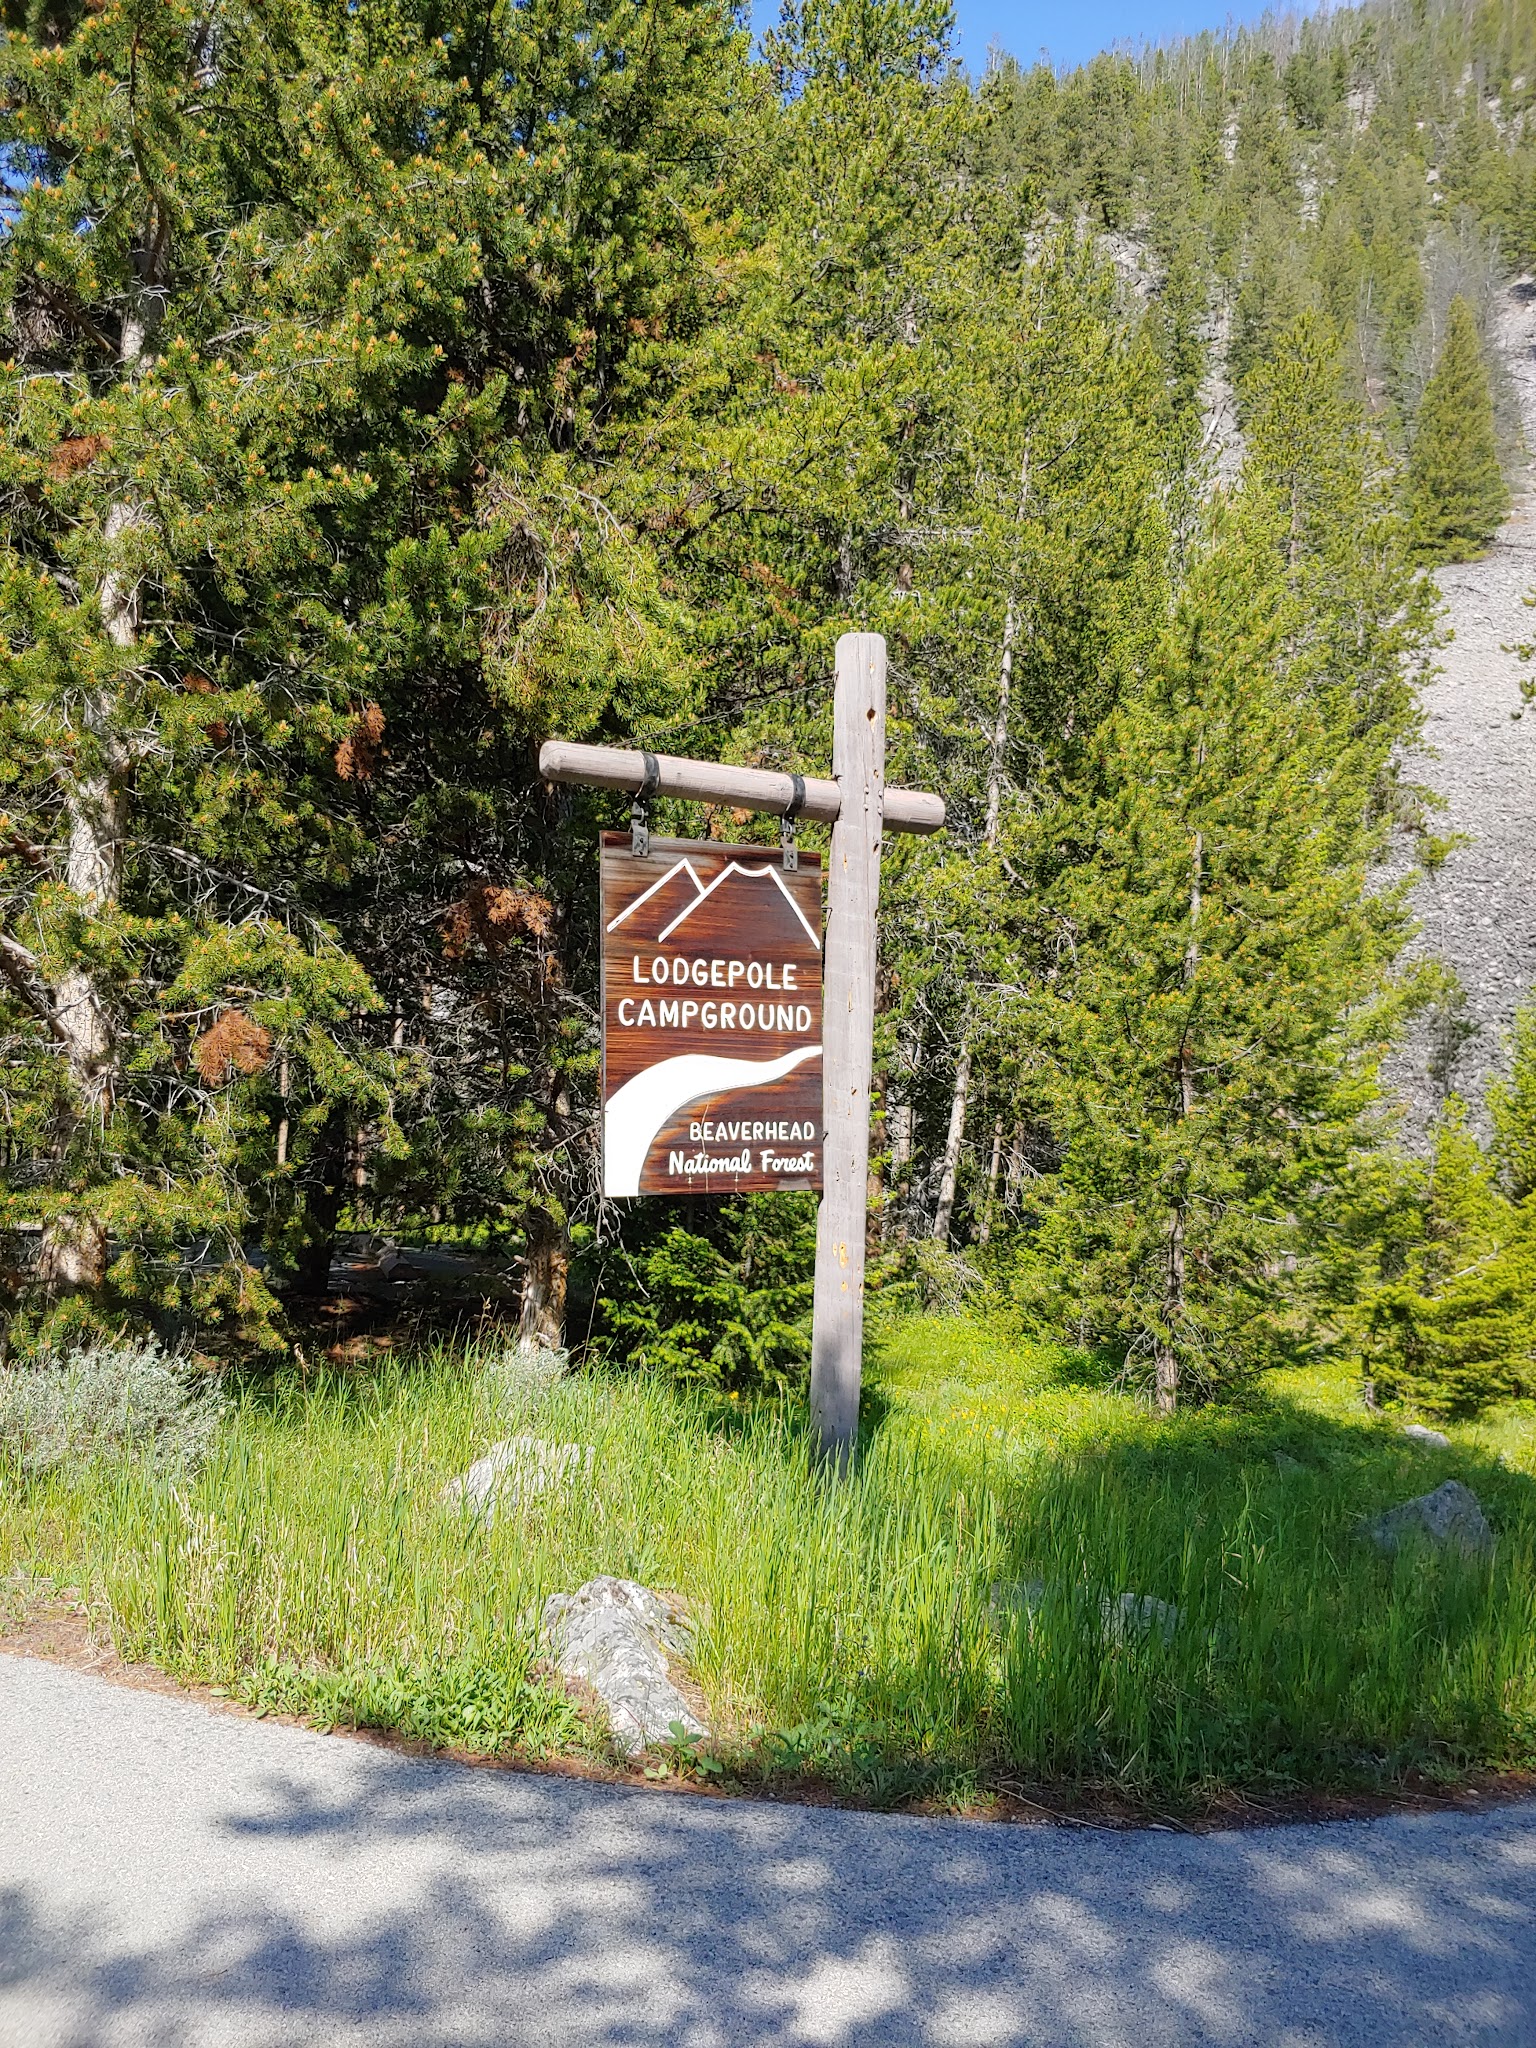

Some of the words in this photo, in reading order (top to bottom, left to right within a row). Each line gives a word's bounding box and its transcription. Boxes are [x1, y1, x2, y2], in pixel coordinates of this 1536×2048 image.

[633, 955, 798, 990] LODGEPOLE
[618, 998, 812, 1032] CAMPGROUND
[689, 1121, 815, 1141] BEAVERHEAD
[669, 1148, 752, 1175] National
[760, 1150, 815, 1172] Forest
